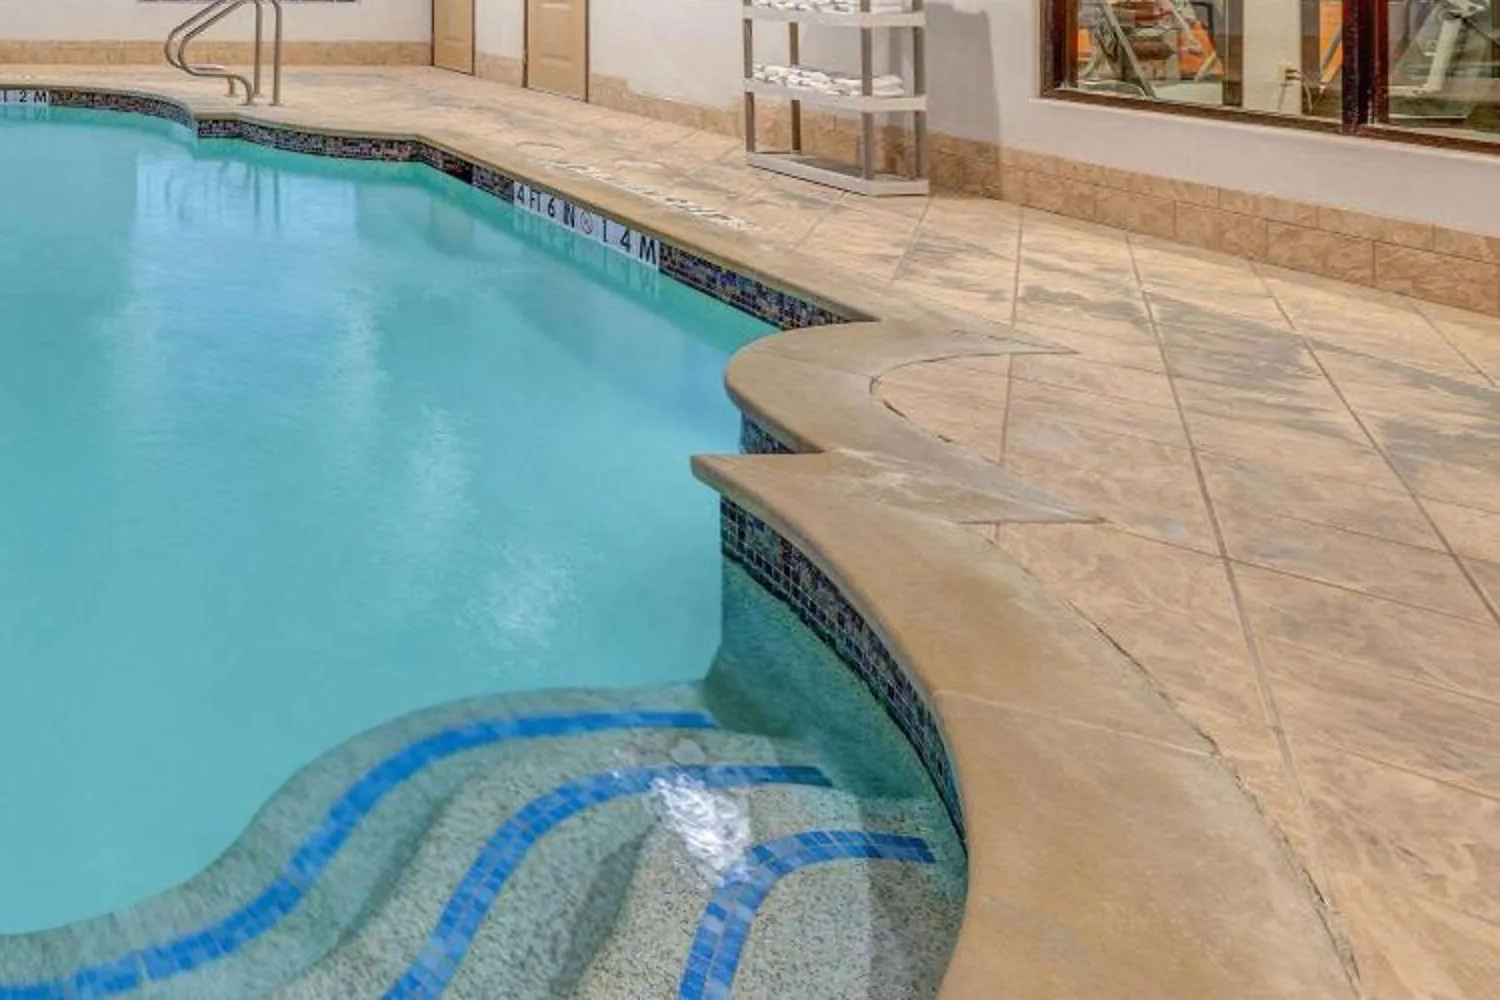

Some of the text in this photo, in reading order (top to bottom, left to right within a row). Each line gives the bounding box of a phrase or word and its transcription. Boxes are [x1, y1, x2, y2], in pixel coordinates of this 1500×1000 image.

[34, 90, 47, 103] M
[516, 186, 525, 205] 4
[529, 189, 541, 213] FT
[547, 197, 556, 218] 6
[639, 235, 657, 265] M
